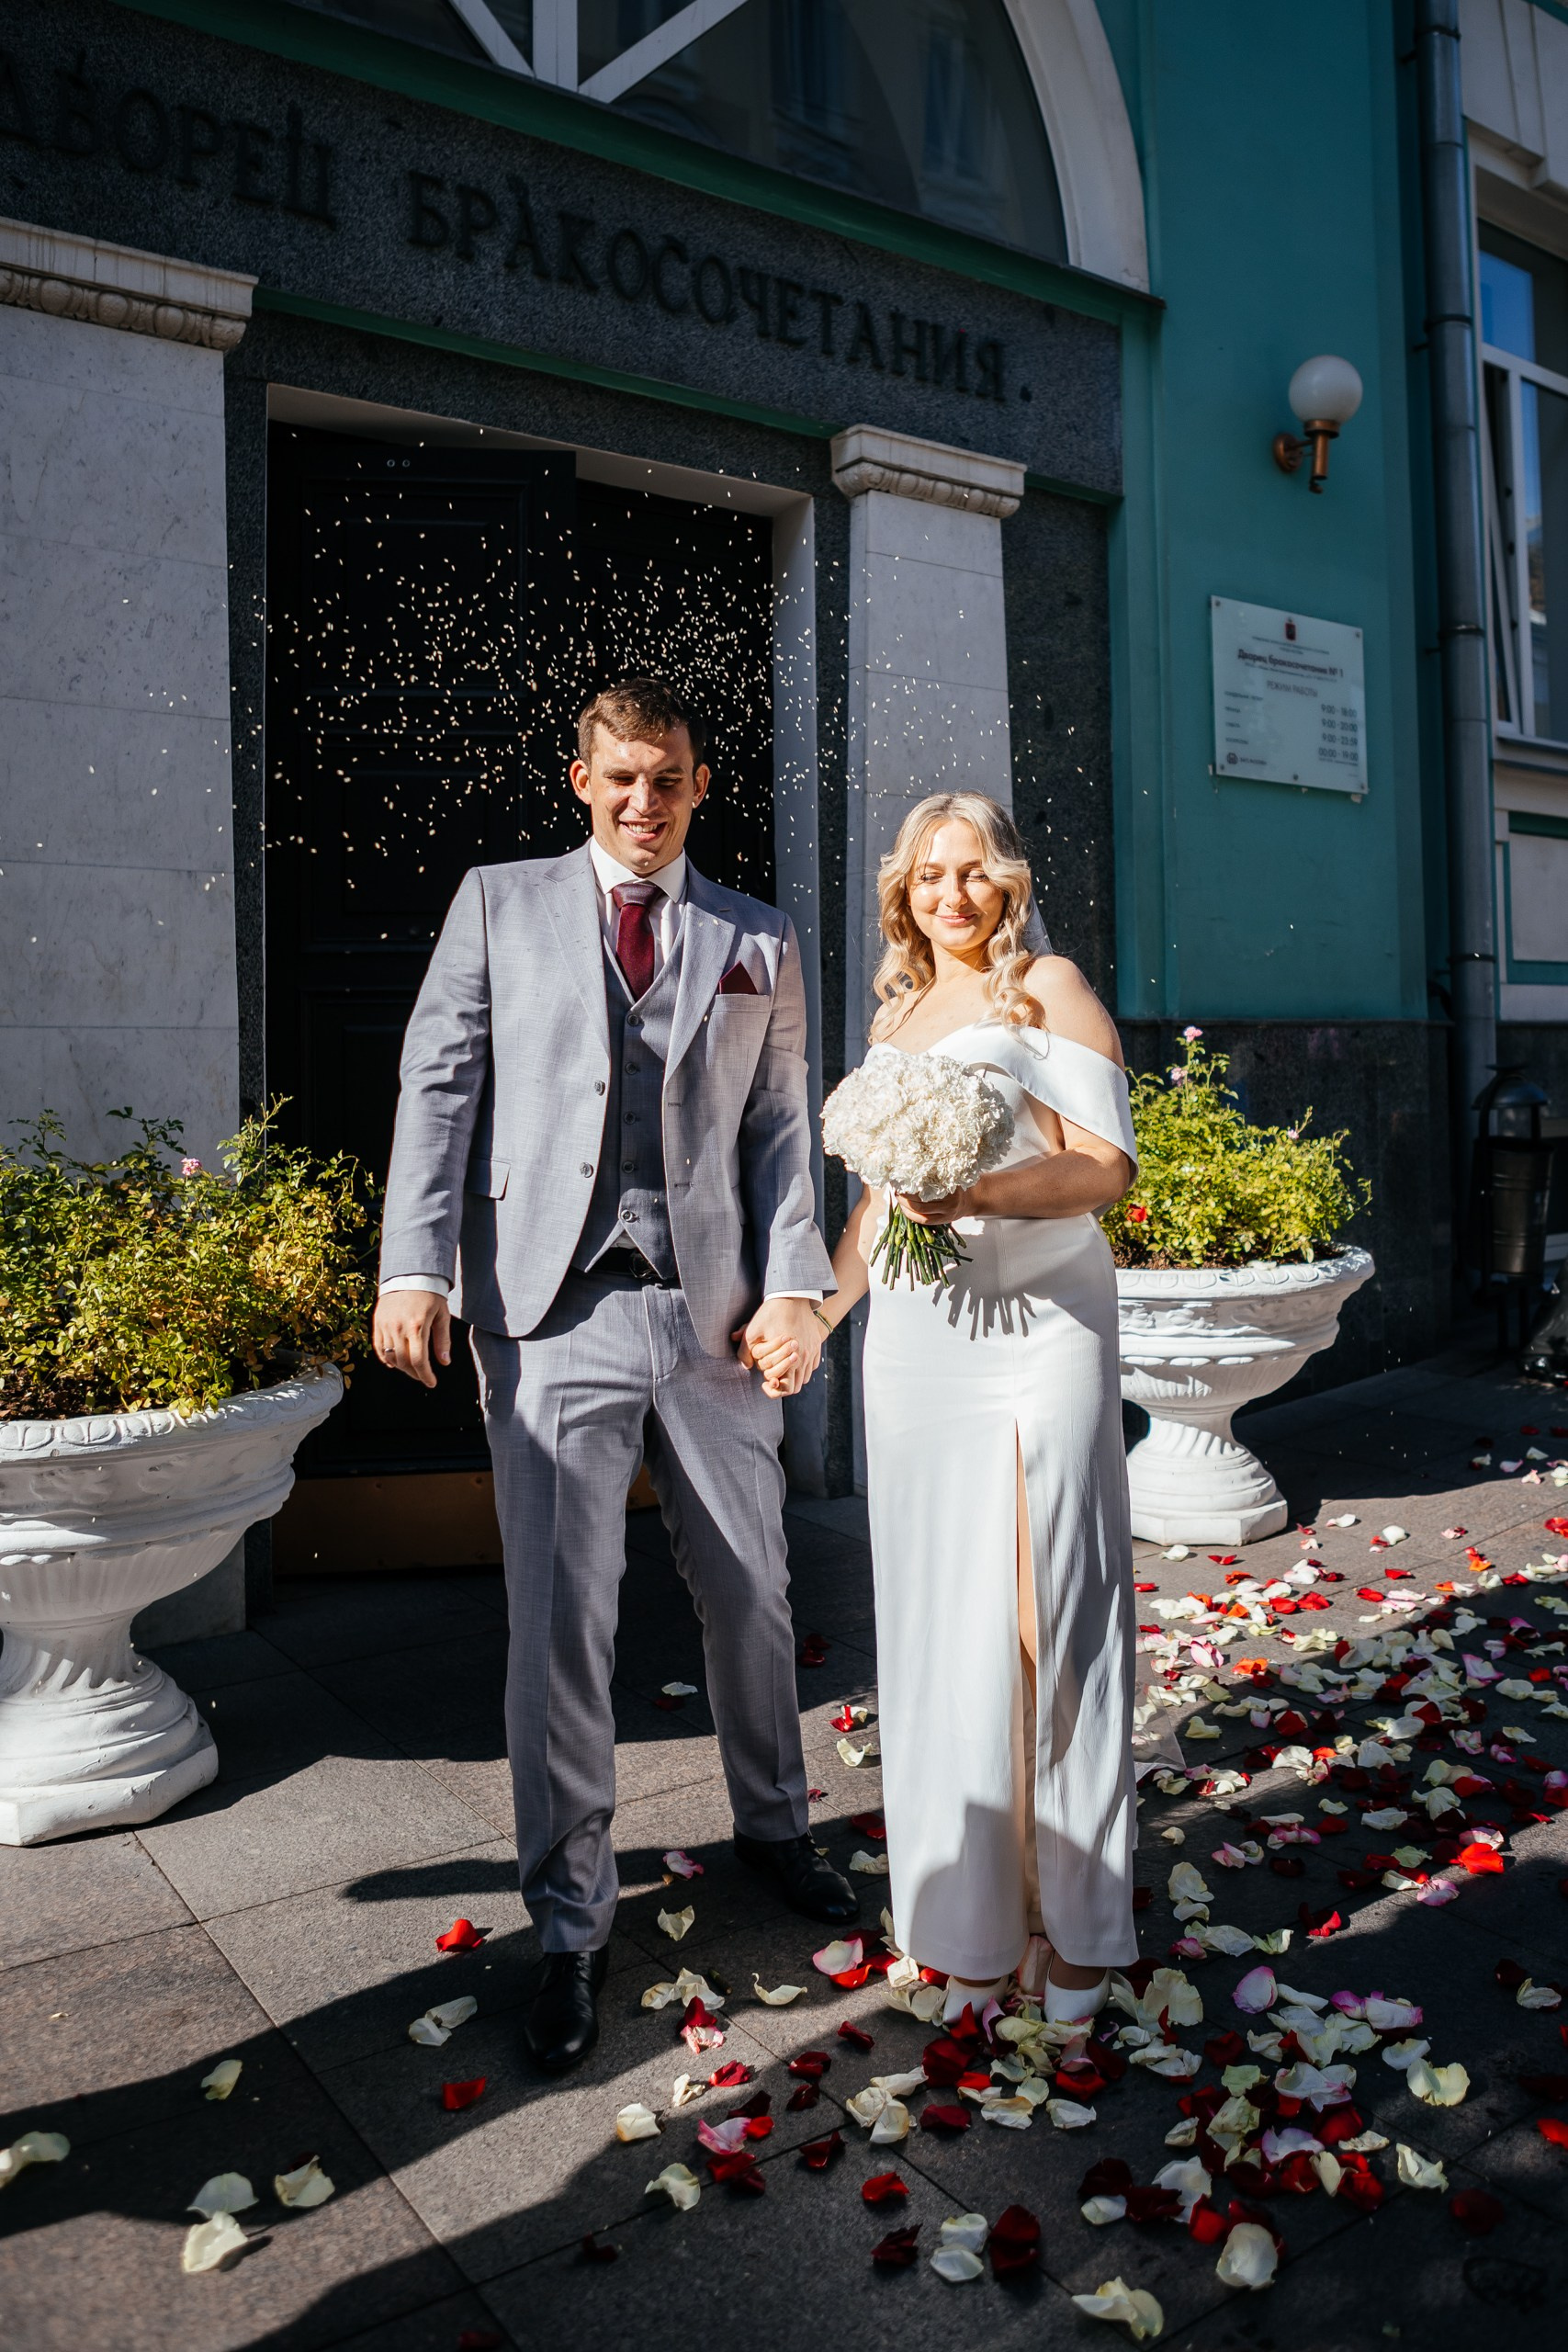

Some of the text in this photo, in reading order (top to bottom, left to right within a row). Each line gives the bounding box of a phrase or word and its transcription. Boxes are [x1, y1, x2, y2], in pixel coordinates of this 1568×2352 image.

[408, 172, 1005, 402] БРАКОСОЧЕТАНИЯ
[1238, 649, 1268, 664] Дворец
[1267, 680, 1318, 697] РЕЖИМ РАБОТЫ
[1321, 704, 1336, 715] 9:00
[1321, 718, 1337, 729] 9:00
[1322, 733, 1337, 743] 9:00
[1318, 747, 1337, 758] 00:00
